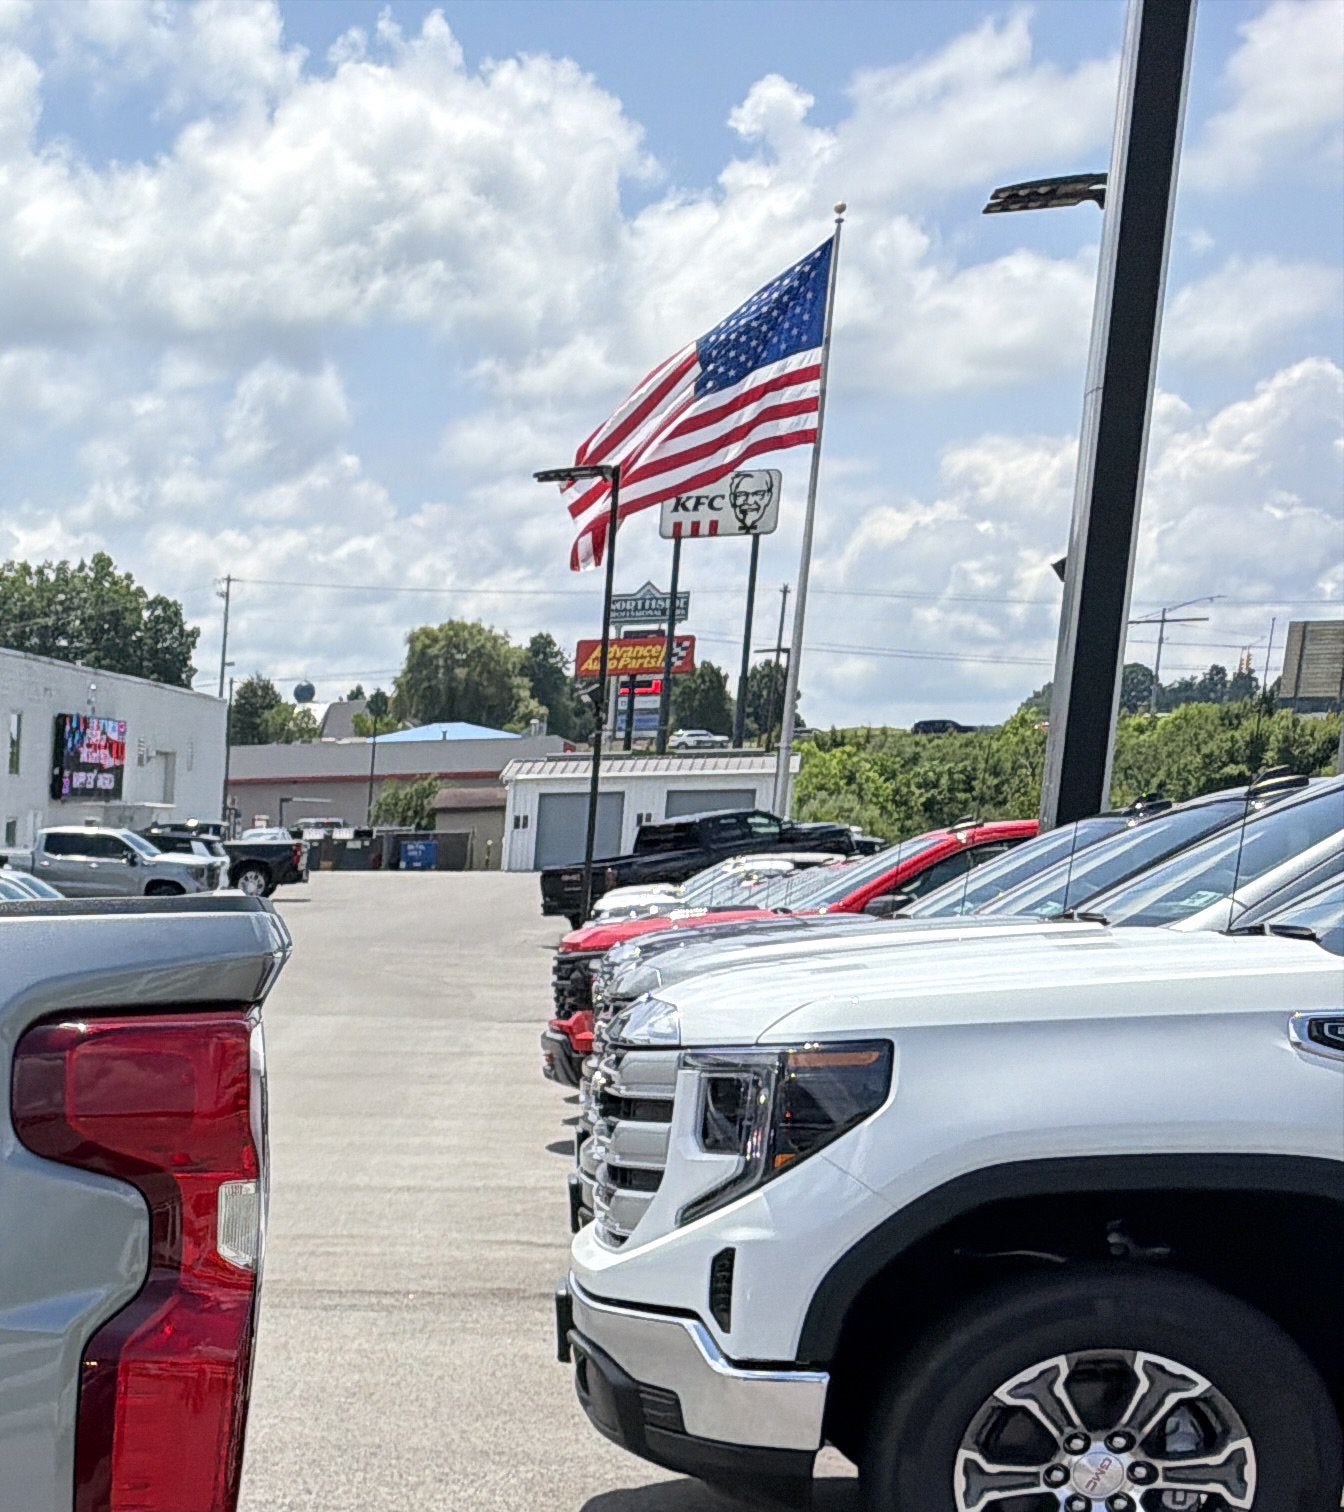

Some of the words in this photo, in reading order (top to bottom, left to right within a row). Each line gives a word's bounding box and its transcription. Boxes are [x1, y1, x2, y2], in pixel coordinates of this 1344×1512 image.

[670, 494, 726, 513] KFC
[580, 658, 618, 671] Auo
[1085, 1457, 1113, 1491] GMC
